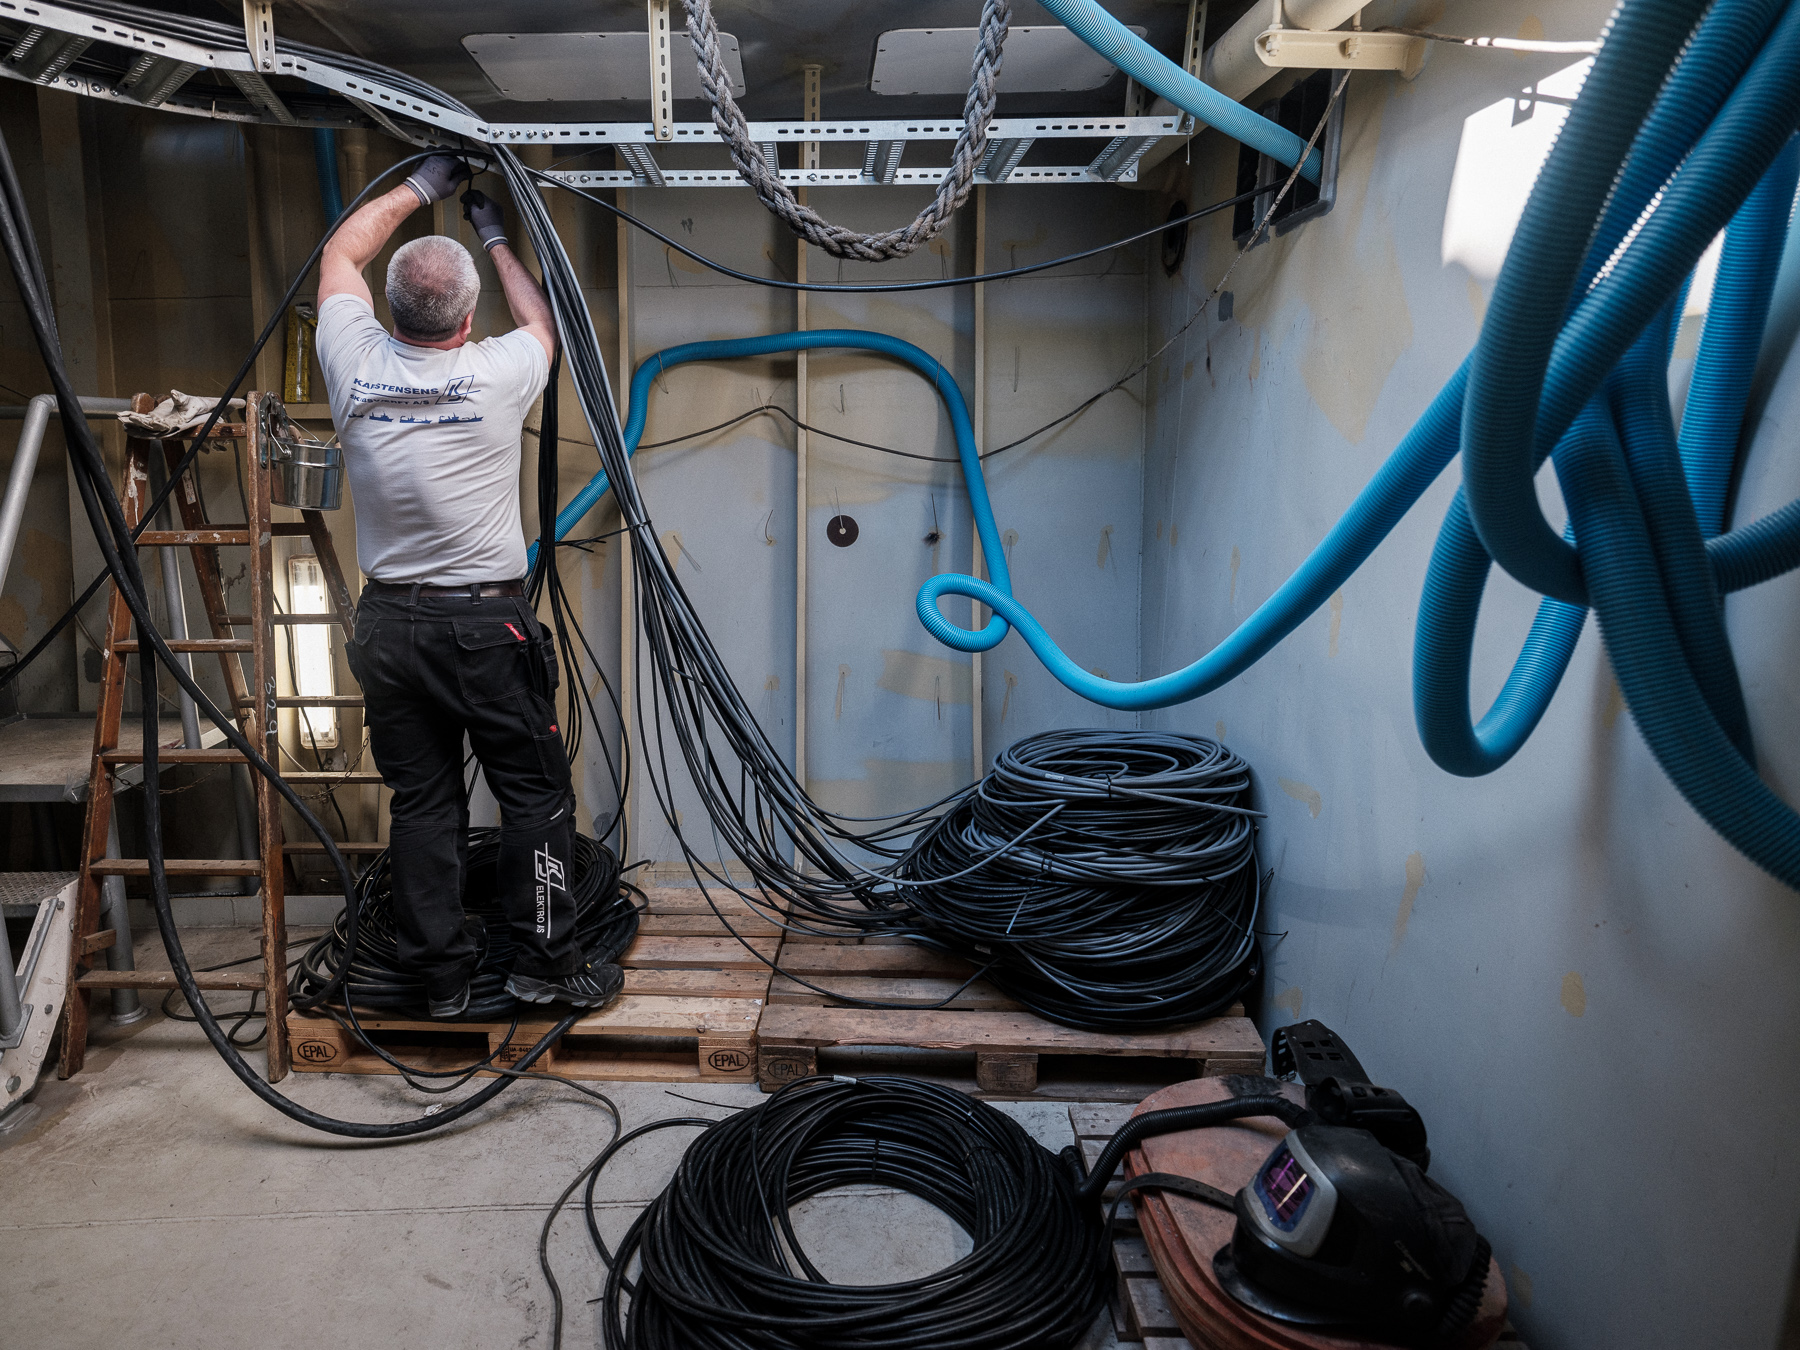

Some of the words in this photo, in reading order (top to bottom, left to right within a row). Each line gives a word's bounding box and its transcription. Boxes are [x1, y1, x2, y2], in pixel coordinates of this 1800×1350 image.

[536, 885, 545, 923] ELEKTRO
[303, 1045, 331, 1058] EPAL
[714, 1054, 744, 1067] EPAL
[773, 1063, 802, 1076] EPAL
